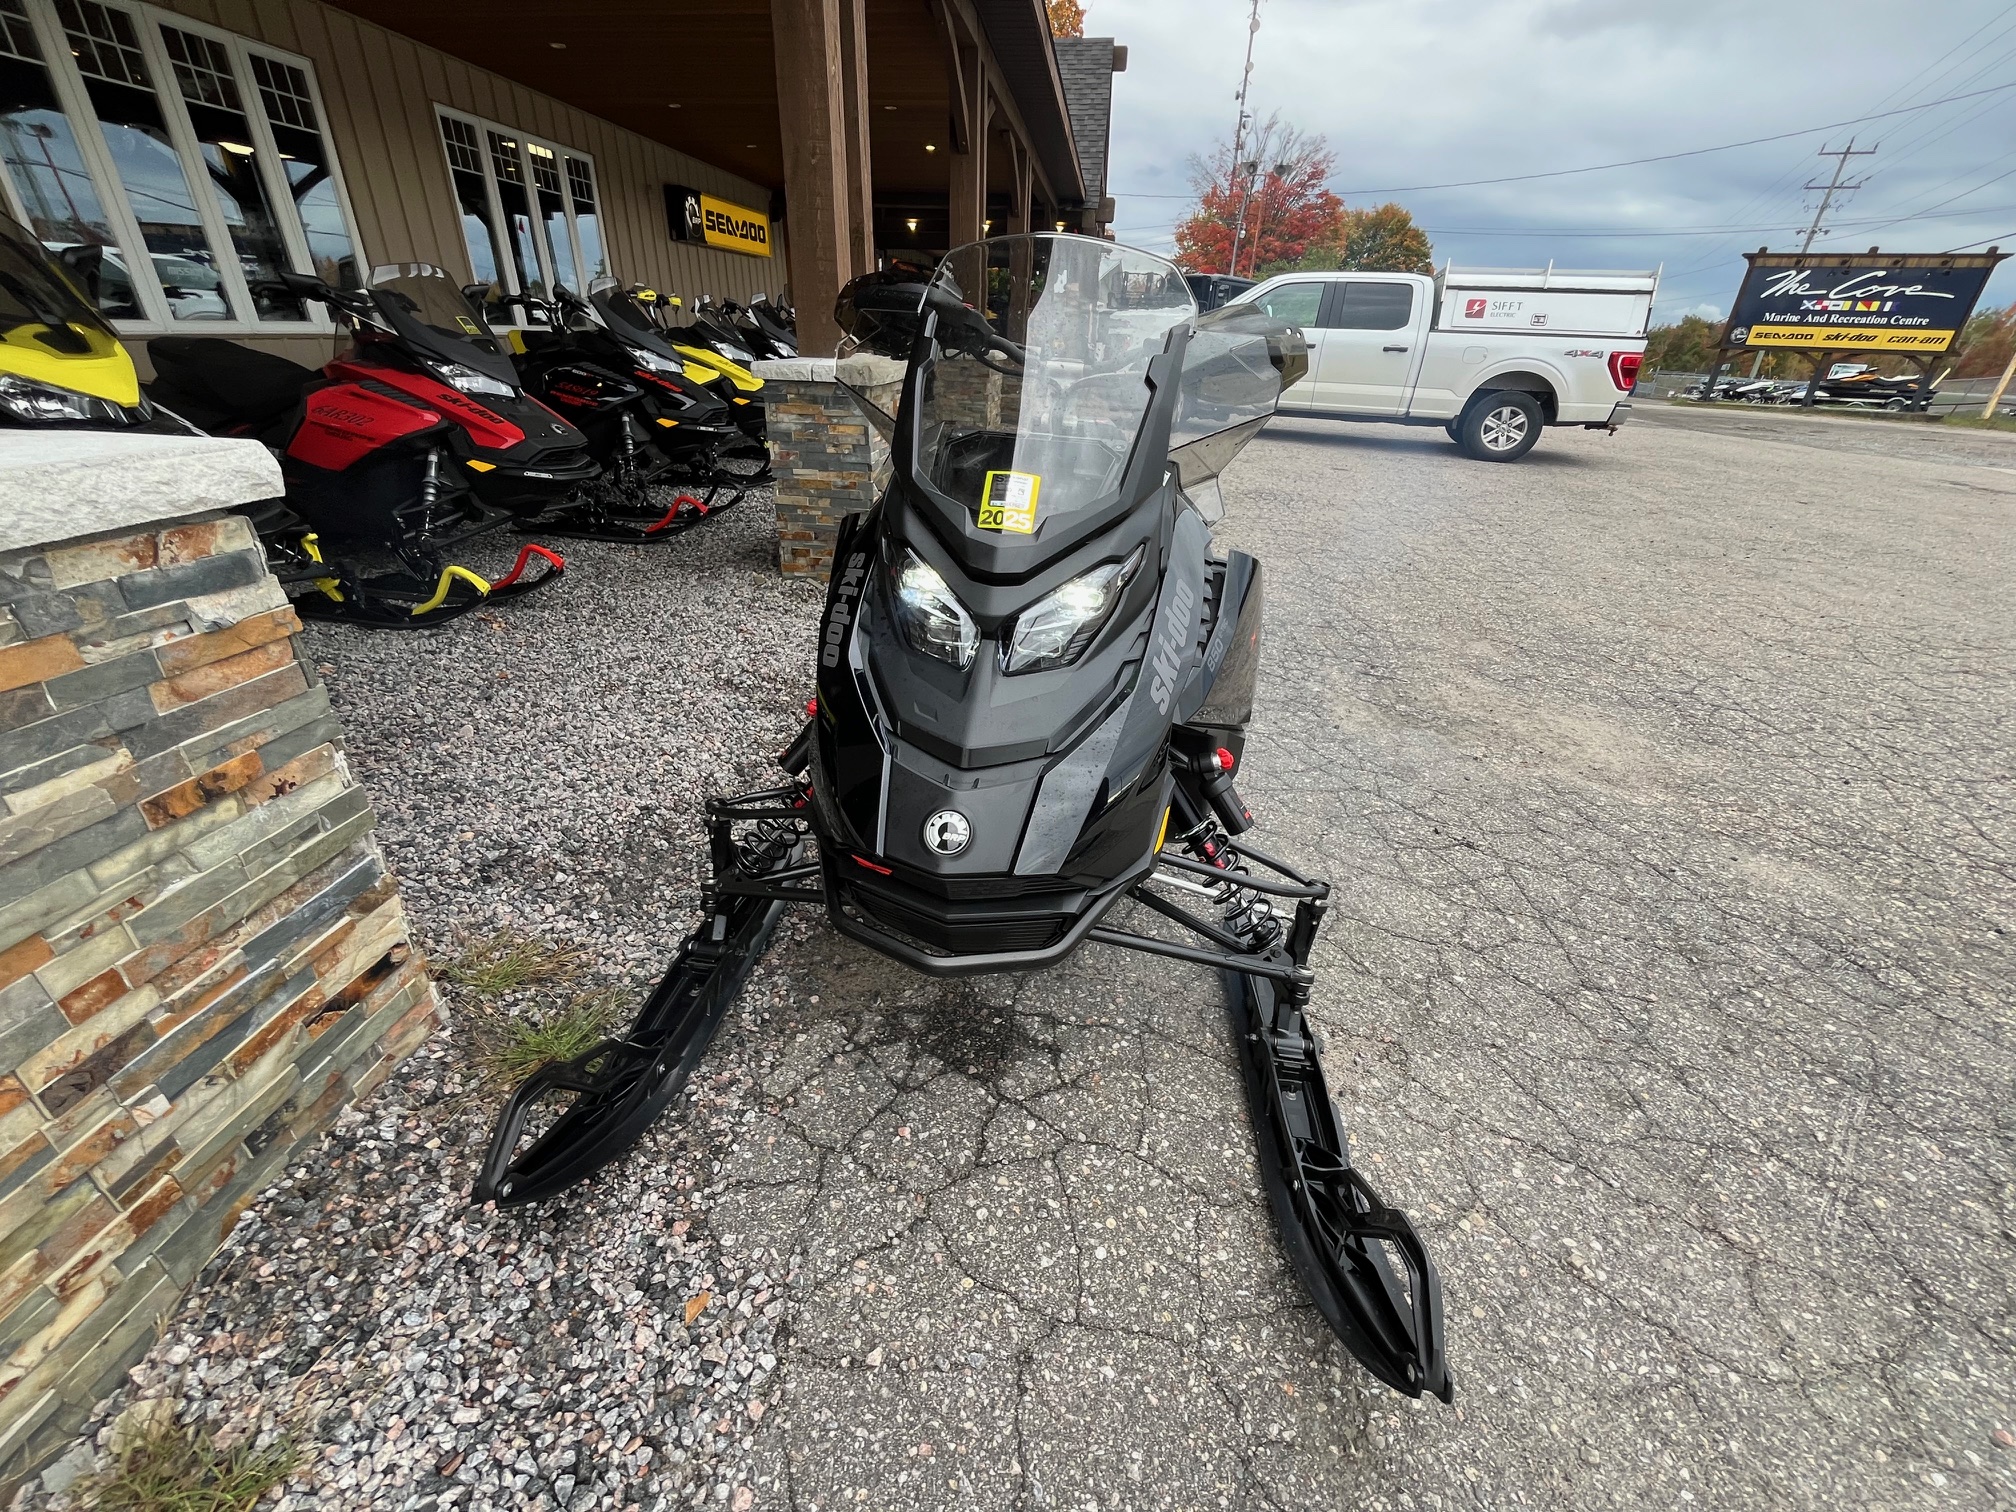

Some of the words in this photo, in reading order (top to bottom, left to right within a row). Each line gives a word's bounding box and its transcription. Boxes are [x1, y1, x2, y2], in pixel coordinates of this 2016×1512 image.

[1760, 269, 1827, 299] The
[1828, 270, 1955, 299] Cove
[1763, 312, 1801, 323] Marine
[1803, 312, 1827, 323] And
[1828, 314, 1889, 325] Recreation
[1890, 315, 1930, 326] Centre
[980, 510, 1031, 530] 2025
[1207, 638, 1223, 673] 850
[941, 832, 967, 843] BRP
